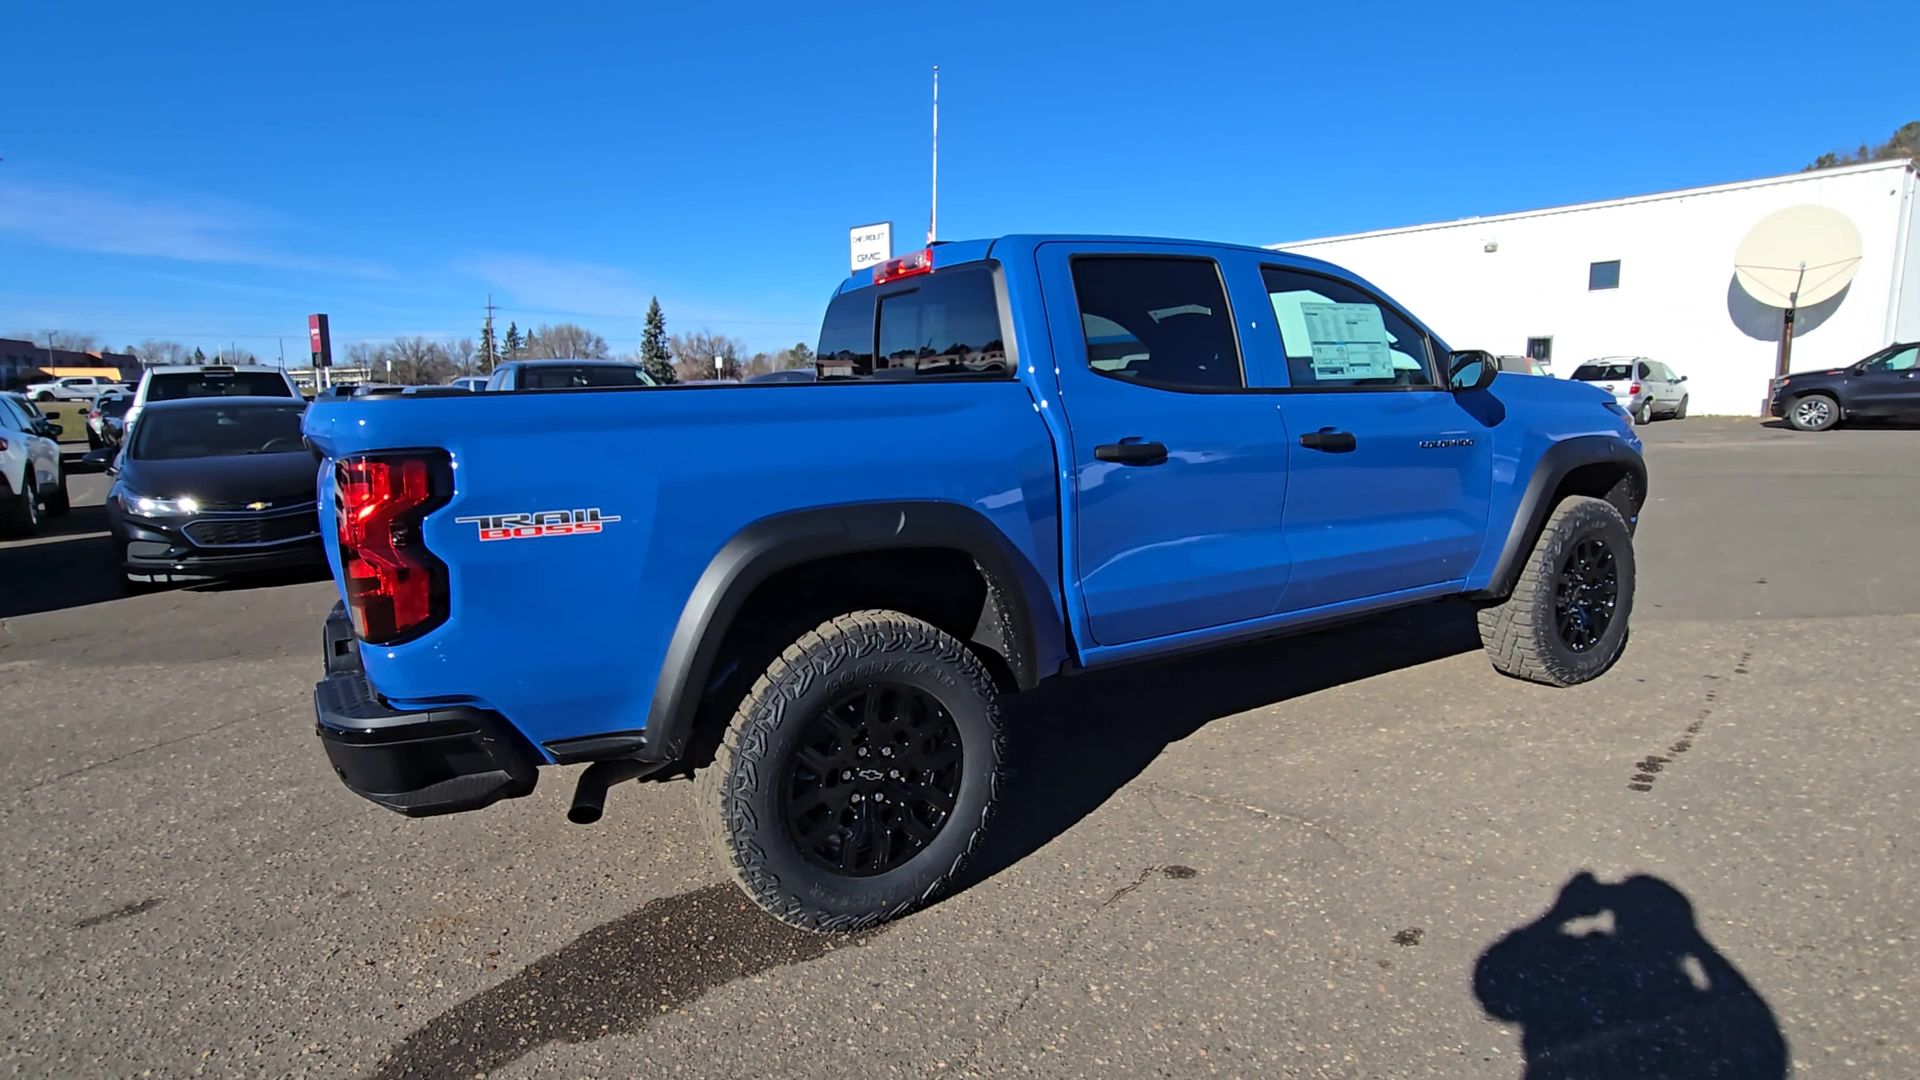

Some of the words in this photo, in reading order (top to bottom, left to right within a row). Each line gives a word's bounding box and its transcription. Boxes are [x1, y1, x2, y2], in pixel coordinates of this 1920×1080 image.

[856, 251, 881, 262] GMC
[1418, 439, 1474, 449] COLORADO
[455, 508, 621, 530] TRAIL
[480, 521, 603, 541] BOSS
